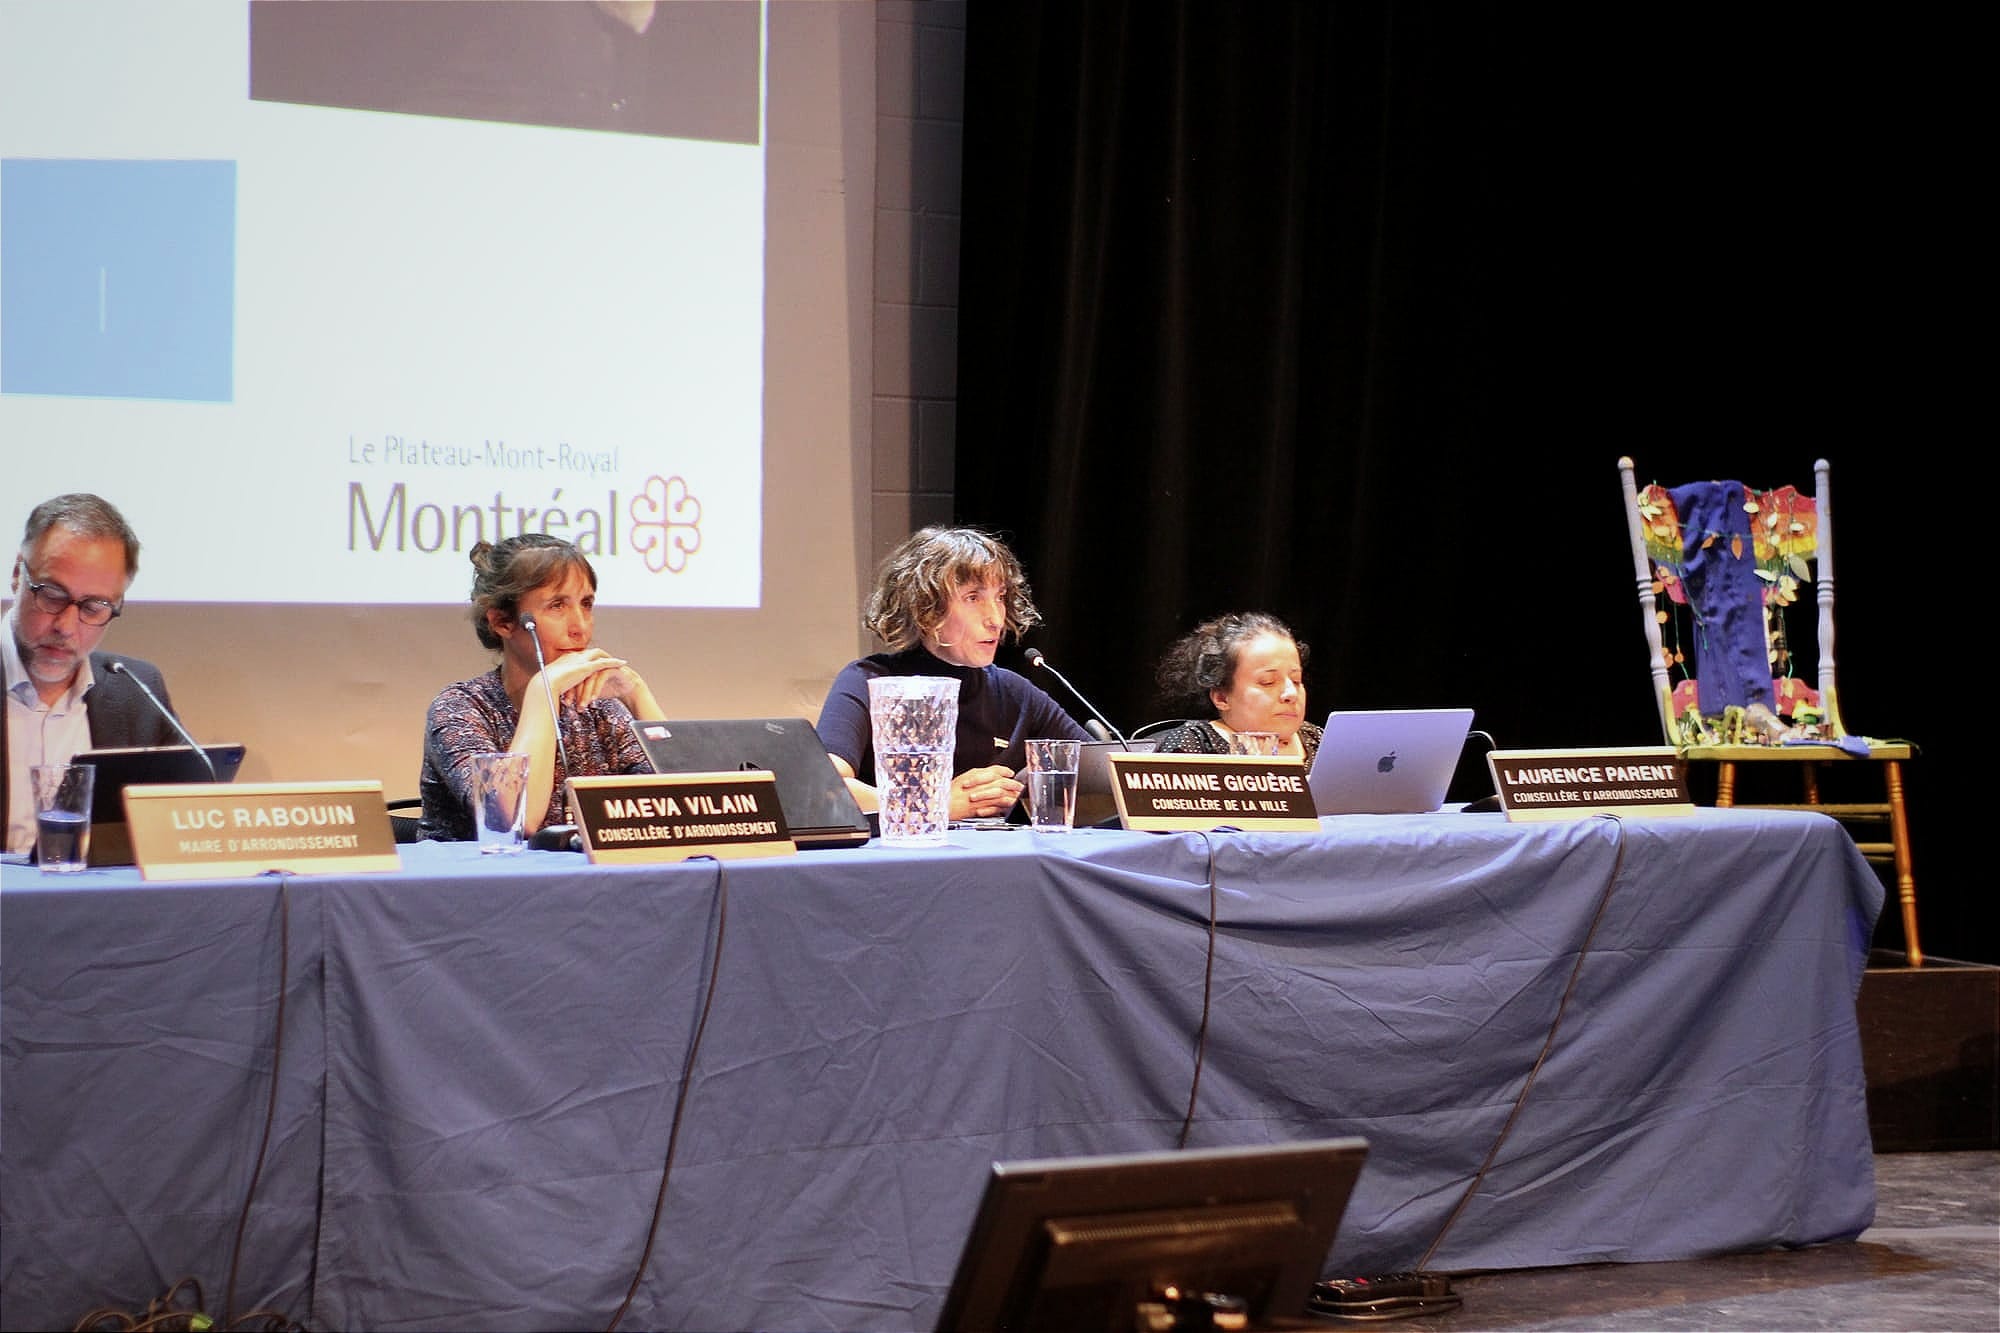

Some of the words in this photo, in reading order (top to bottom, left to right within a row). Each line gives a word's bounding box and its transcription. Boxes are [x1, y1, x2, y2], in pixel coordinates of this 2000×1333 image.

[348, 434, 375, 465] Le
[384, 434, 619, 478] Plateau-Mont-Royal
[347, 481, 618, 557] Montréal
[1124, 772, 1221, 791] MARIANNE
[1224, 772, 1304, 793] GIGUÈRE
[1504, 766, 1603, 785] LAURENCE
[1605, 765, 1674, 783] PARENT
[1152, 797, 1222, 811] CONSEILLÈRE
[1225, 799, 1240, 811] DE
[1242, 799, 1258, 811] LA
[1259, 800, 1289, 812] VILLE
[1513, 789, 1580, 803] CONSEILLÈRE
[1583, 788, 1678, 801] D'ARRONDISSEMENT
[604, 797, 681, 819] MAEVA
[687, 794, 758, 815] VILAIN
[172, 808, 225, 831] LUC
[233, 805, 355, 829] RABOUIN
[598, 824, 672, 843] CONSEILLÈRE
[675, 821, 777, 840] D'ARRONDISSEMENT
[179, 839, 223, 854] MAIRE
[228, 834, 359, 853] D'ARRONDISSEMENT
